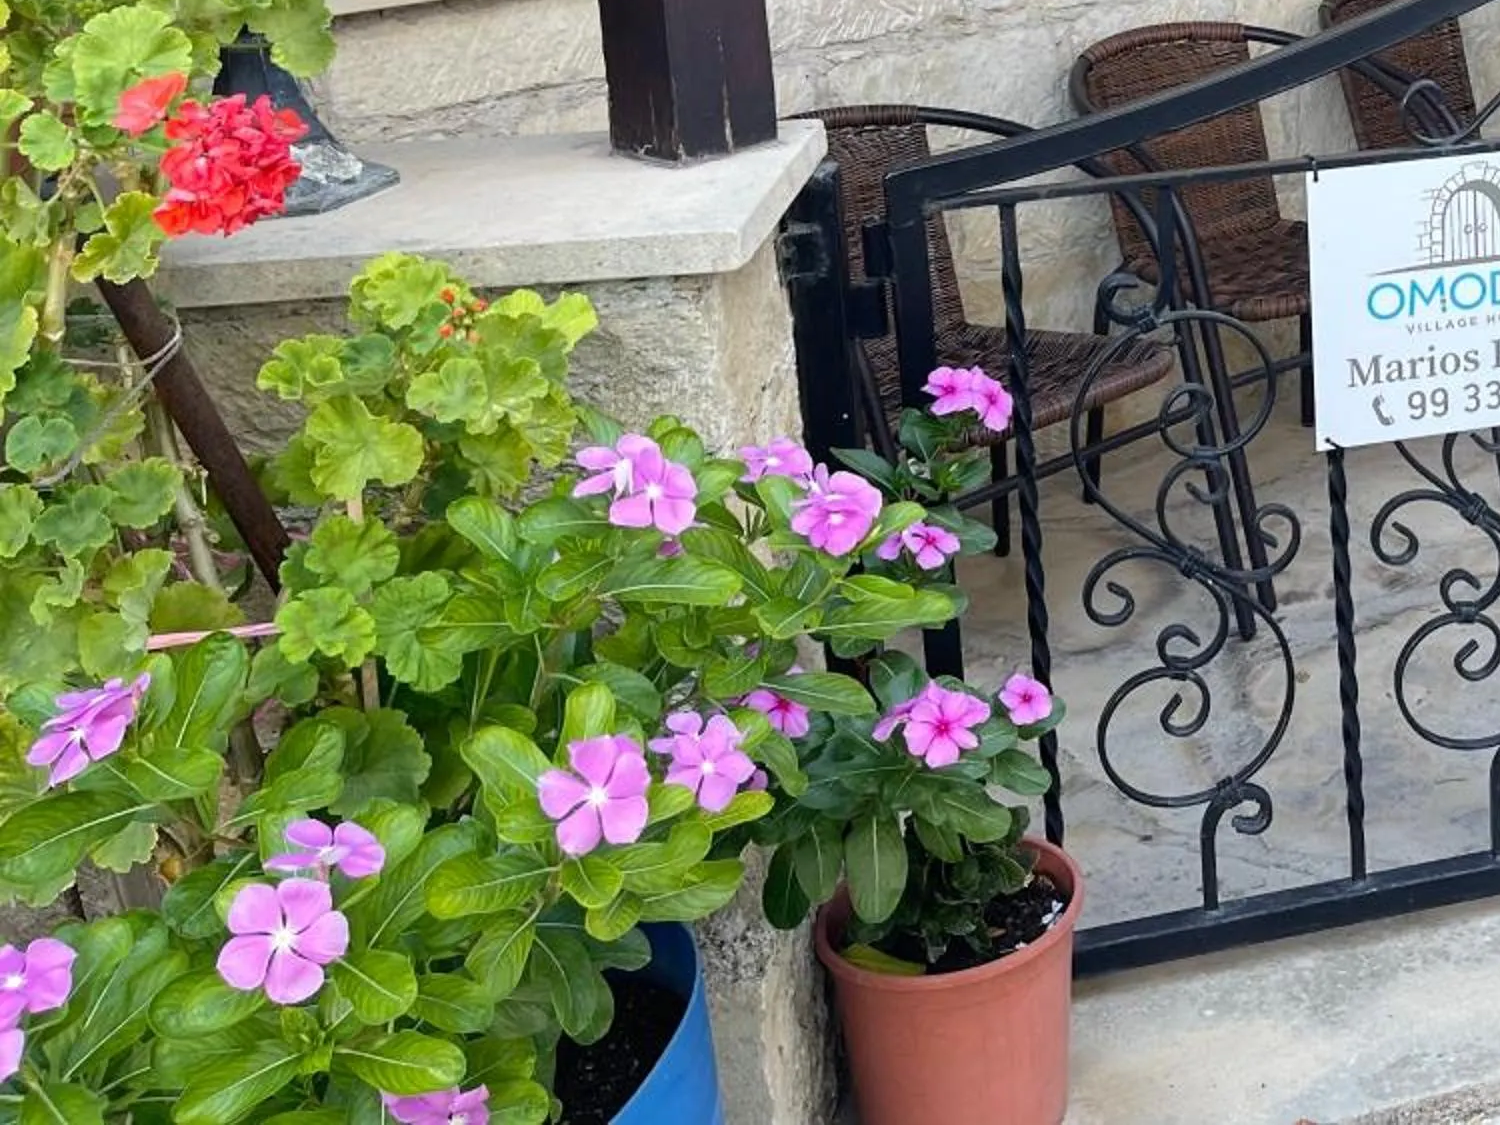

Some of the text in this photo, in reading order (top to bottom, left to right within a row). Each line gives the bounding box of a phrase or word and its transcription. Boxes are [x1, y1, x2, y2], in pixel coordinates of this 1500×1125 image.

[1406, 316, 1479, 336] VILLAGE
[1347, 345, 1480, 388] Marios
[1407, 387, 1450, 420] 99
